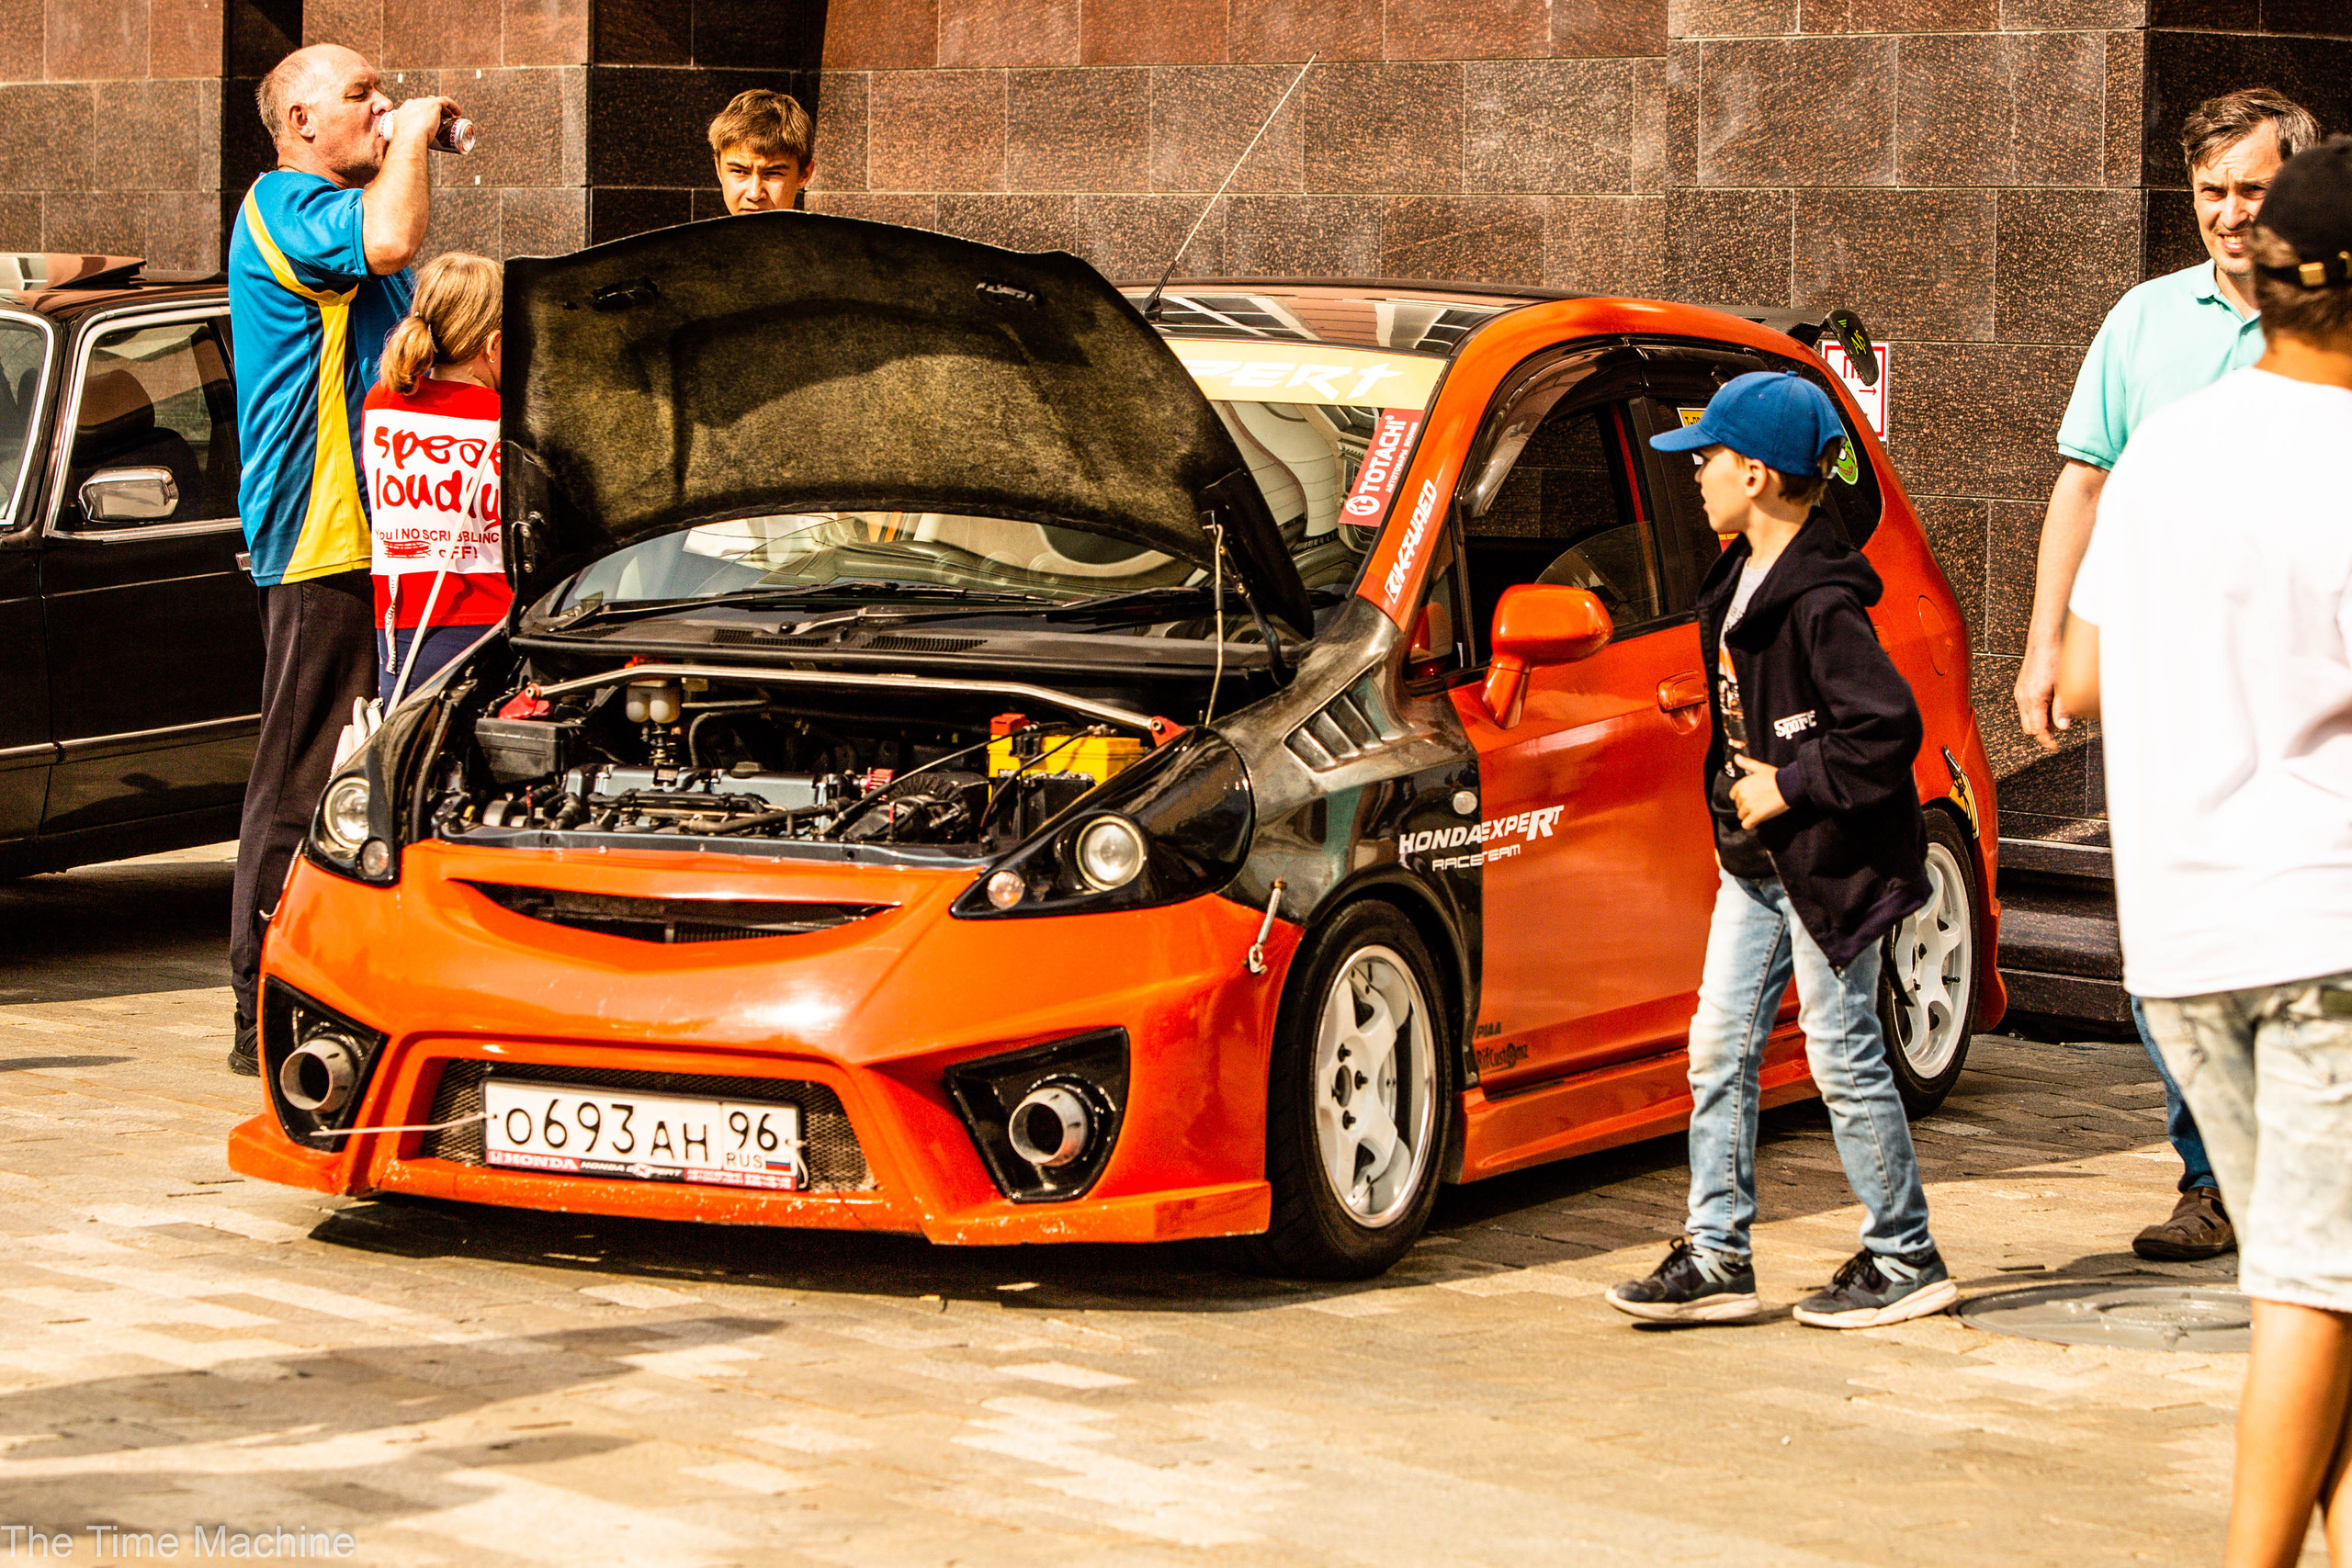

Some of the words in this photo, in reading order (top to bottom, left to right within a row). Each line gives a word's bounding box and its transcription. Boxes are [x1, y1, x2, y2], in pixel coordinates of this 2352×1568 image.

[401, 528, 420, 540] NO
[1773, 709, 1817, 739] Sport
[729, 1111, 778, 1151] 96
[503, 1152, 579, 1170] HONDA
[727, 1152, 763, 1168] RUS
